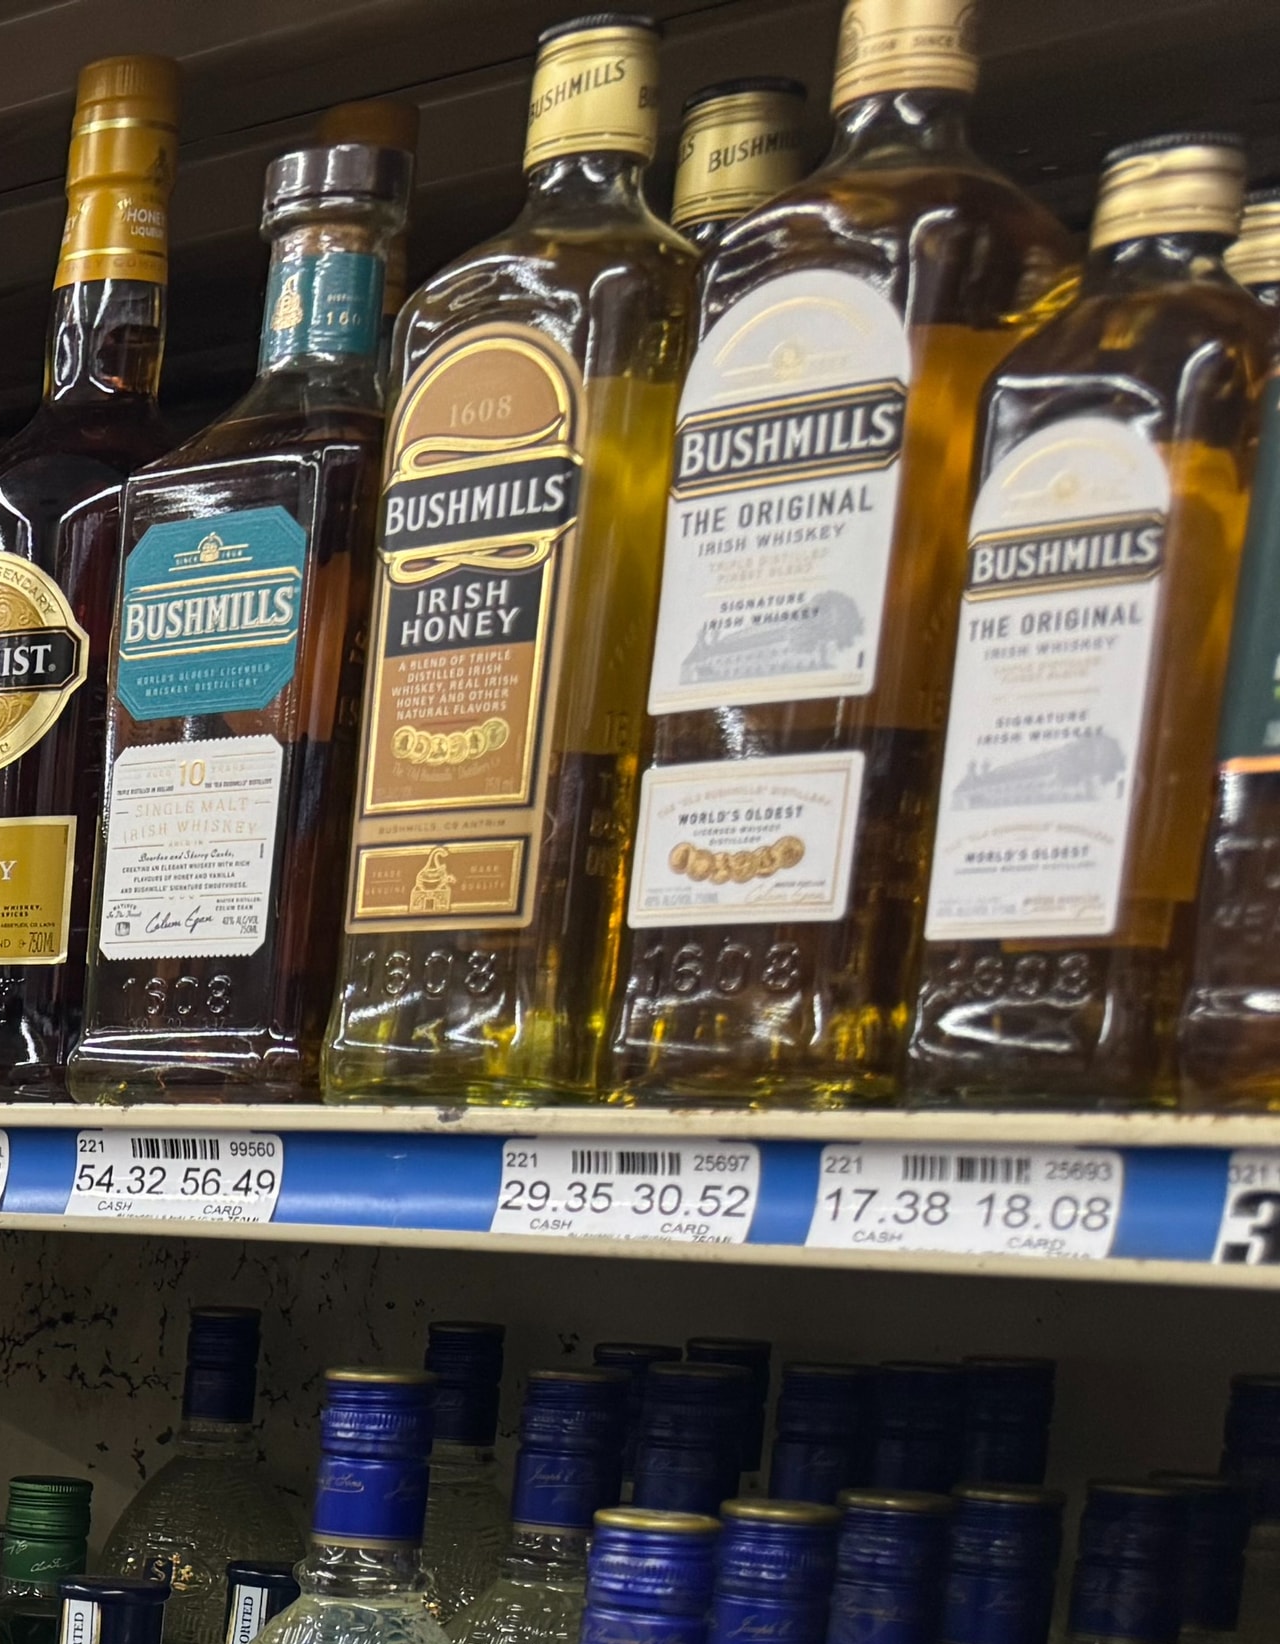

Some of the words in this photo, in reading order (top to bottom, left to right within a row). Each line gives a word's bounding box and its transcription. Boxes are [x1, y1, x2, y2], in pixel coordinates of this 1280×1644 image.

[449, 395, 512, 428] 1608
[679, 405, 896, 479] BUSHMILLS
[385, 474, 564, 537] BUSHMILLS
[681, 510, 726, 537] THE
[738, 486, 873, 528] ORIGINAL
[971, 528, 1159, 586] BUSHMILLS
[125, 586, 294, 644] BUSHMILLS
[415, 580, 509, 616] IRISH
[400, 607, 520, 645] HONEY
[968, 616, 1011, 642] THE
[1020, 603, 1143, 636] ORIGINAL
[178, 759, 206, 788] 10
[230, 1142, 275, 1157] 99560
[693, 1155, 749, 1172] 25697
[75, 1165, 165, 1197] 54.32
[180, 1166, 275, 1198] 56.49
[500, 1180, 614, 1213] 29.35
[632, 1183, 751, 1218] 30.52
[824, 1187, 950, 1226] 17.38
[977, 1193, 1111, 1231] 18.08
